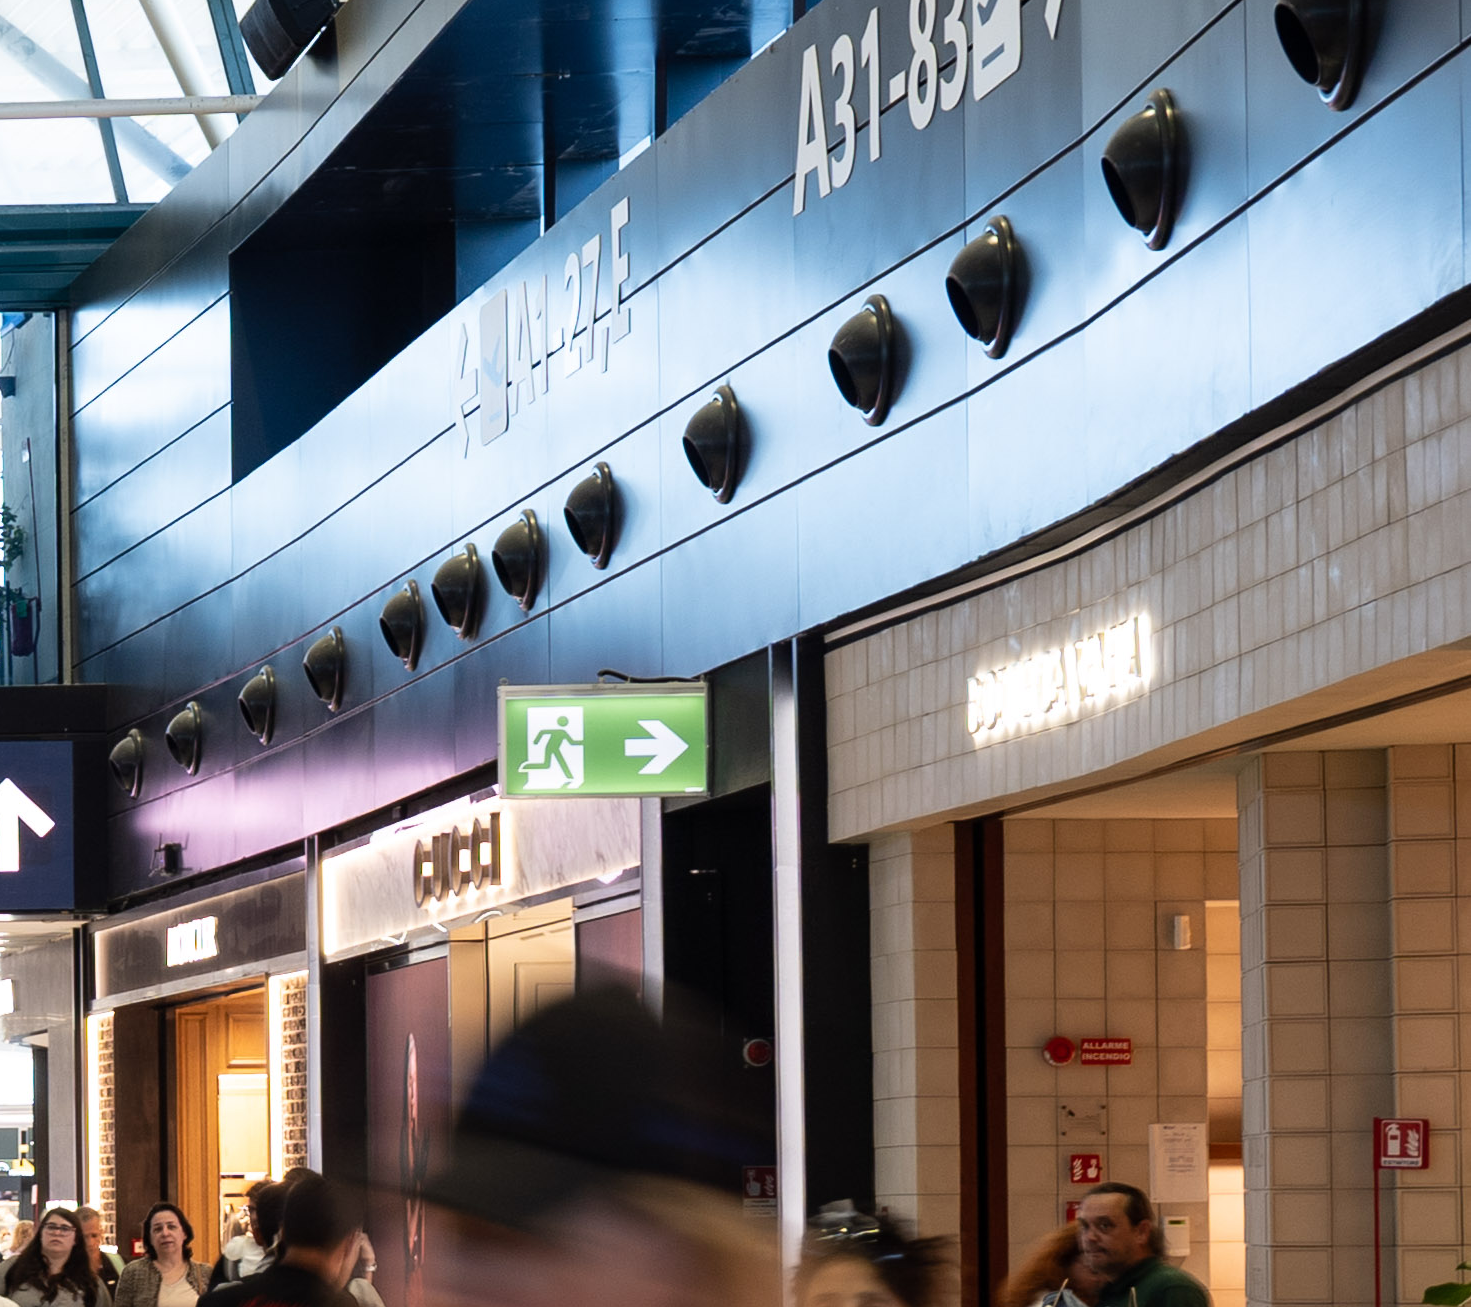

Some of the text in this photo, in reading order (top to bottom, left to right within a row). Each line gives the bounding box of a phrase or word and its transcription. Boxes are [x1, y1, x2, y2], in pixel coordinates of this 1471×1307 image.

[611, 197, 632, 347] E
[1082, 1042, 1129, 1050] ALLARME
[1081, 1053, 1131, 1061] INCENDIO
